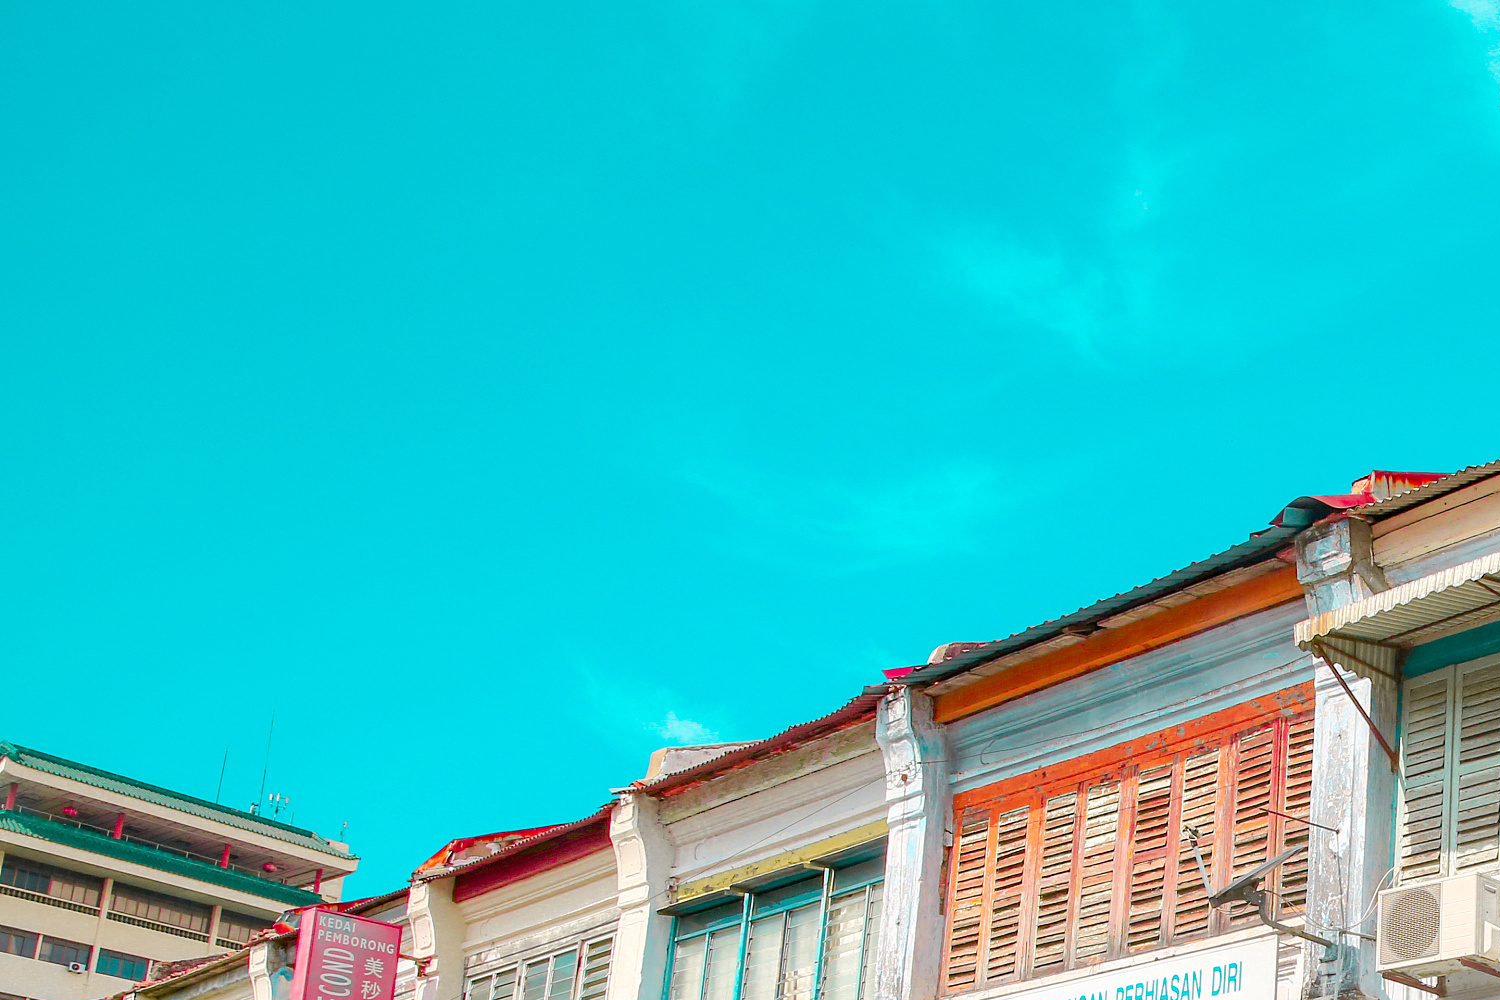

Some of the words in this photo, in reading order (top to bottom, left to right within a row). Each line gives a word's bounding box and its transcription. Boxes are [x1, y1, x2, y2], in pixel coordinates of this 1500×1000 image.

[319, 915, 357, 933] KEDAI
[317, 929, 396, 955] PEMBORONG
[1211, 961, 1243, 997] DIRI
